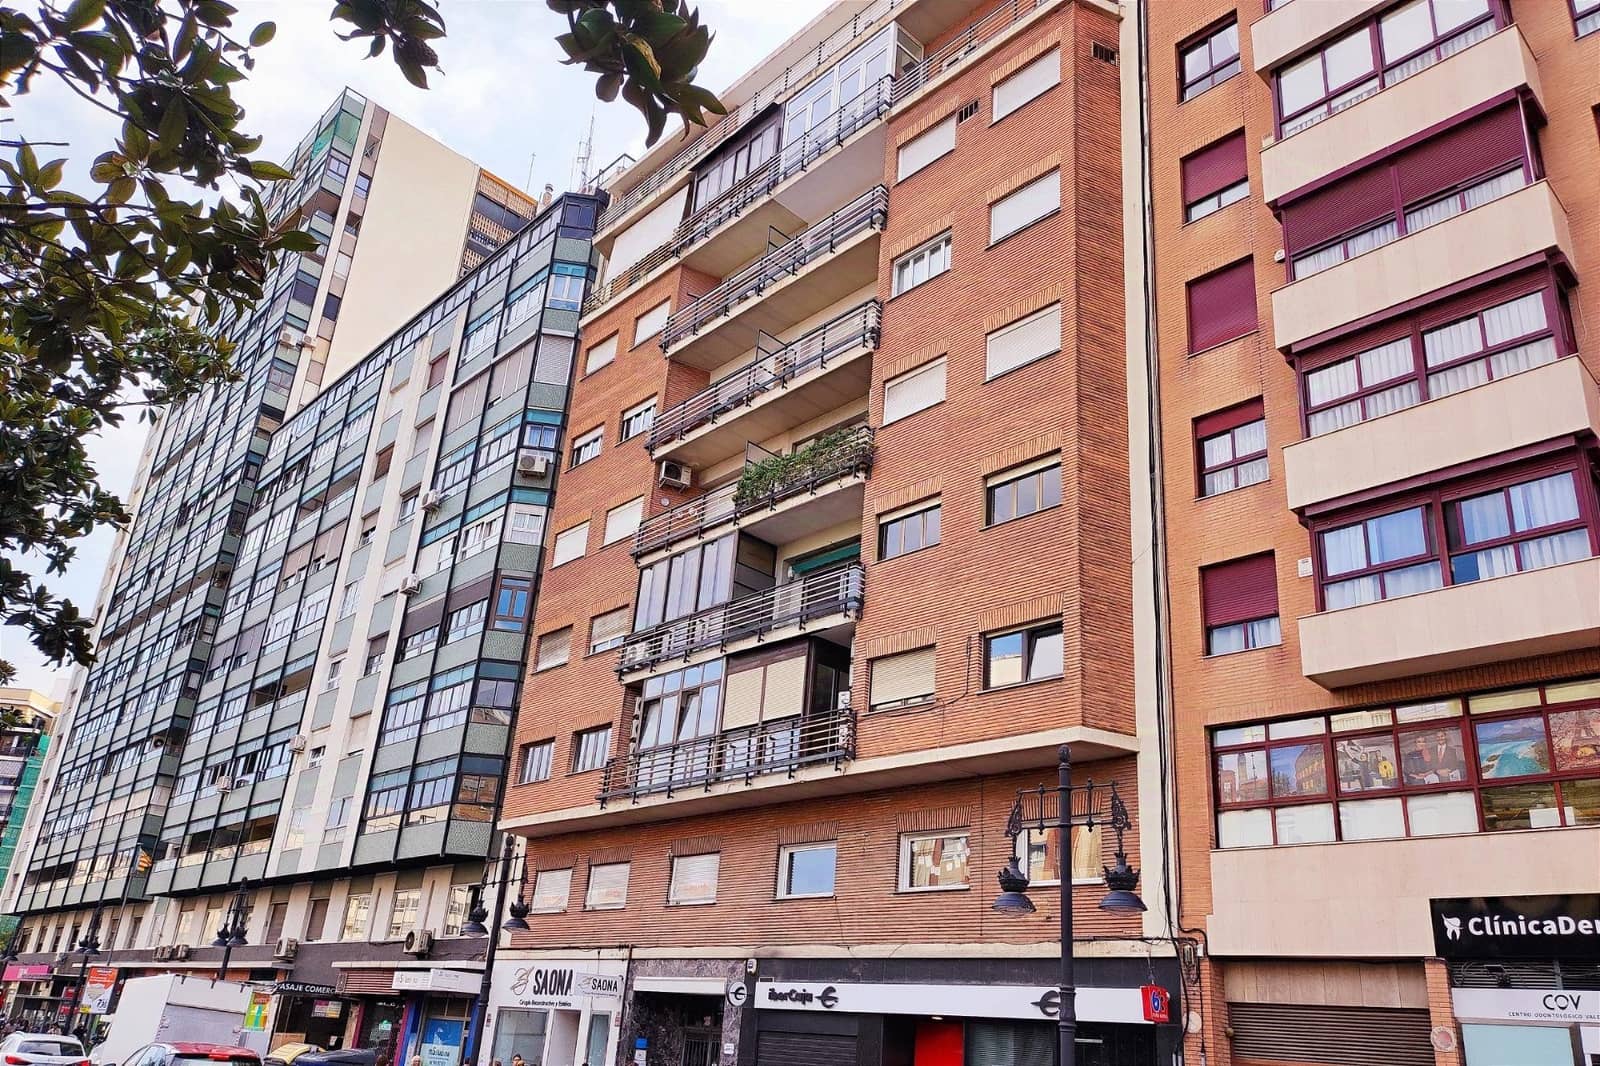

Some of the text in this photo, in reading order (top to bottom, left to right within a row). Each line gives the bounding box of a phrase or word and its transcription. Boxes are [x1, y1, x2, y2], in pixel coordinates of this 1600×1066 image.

[305, 985, 337, 994] COMERC
[533, 969, 573, 996] SAONA
[592, 978, 618, 992] SAONA
[1543, 994, 1581, 1010] COV
